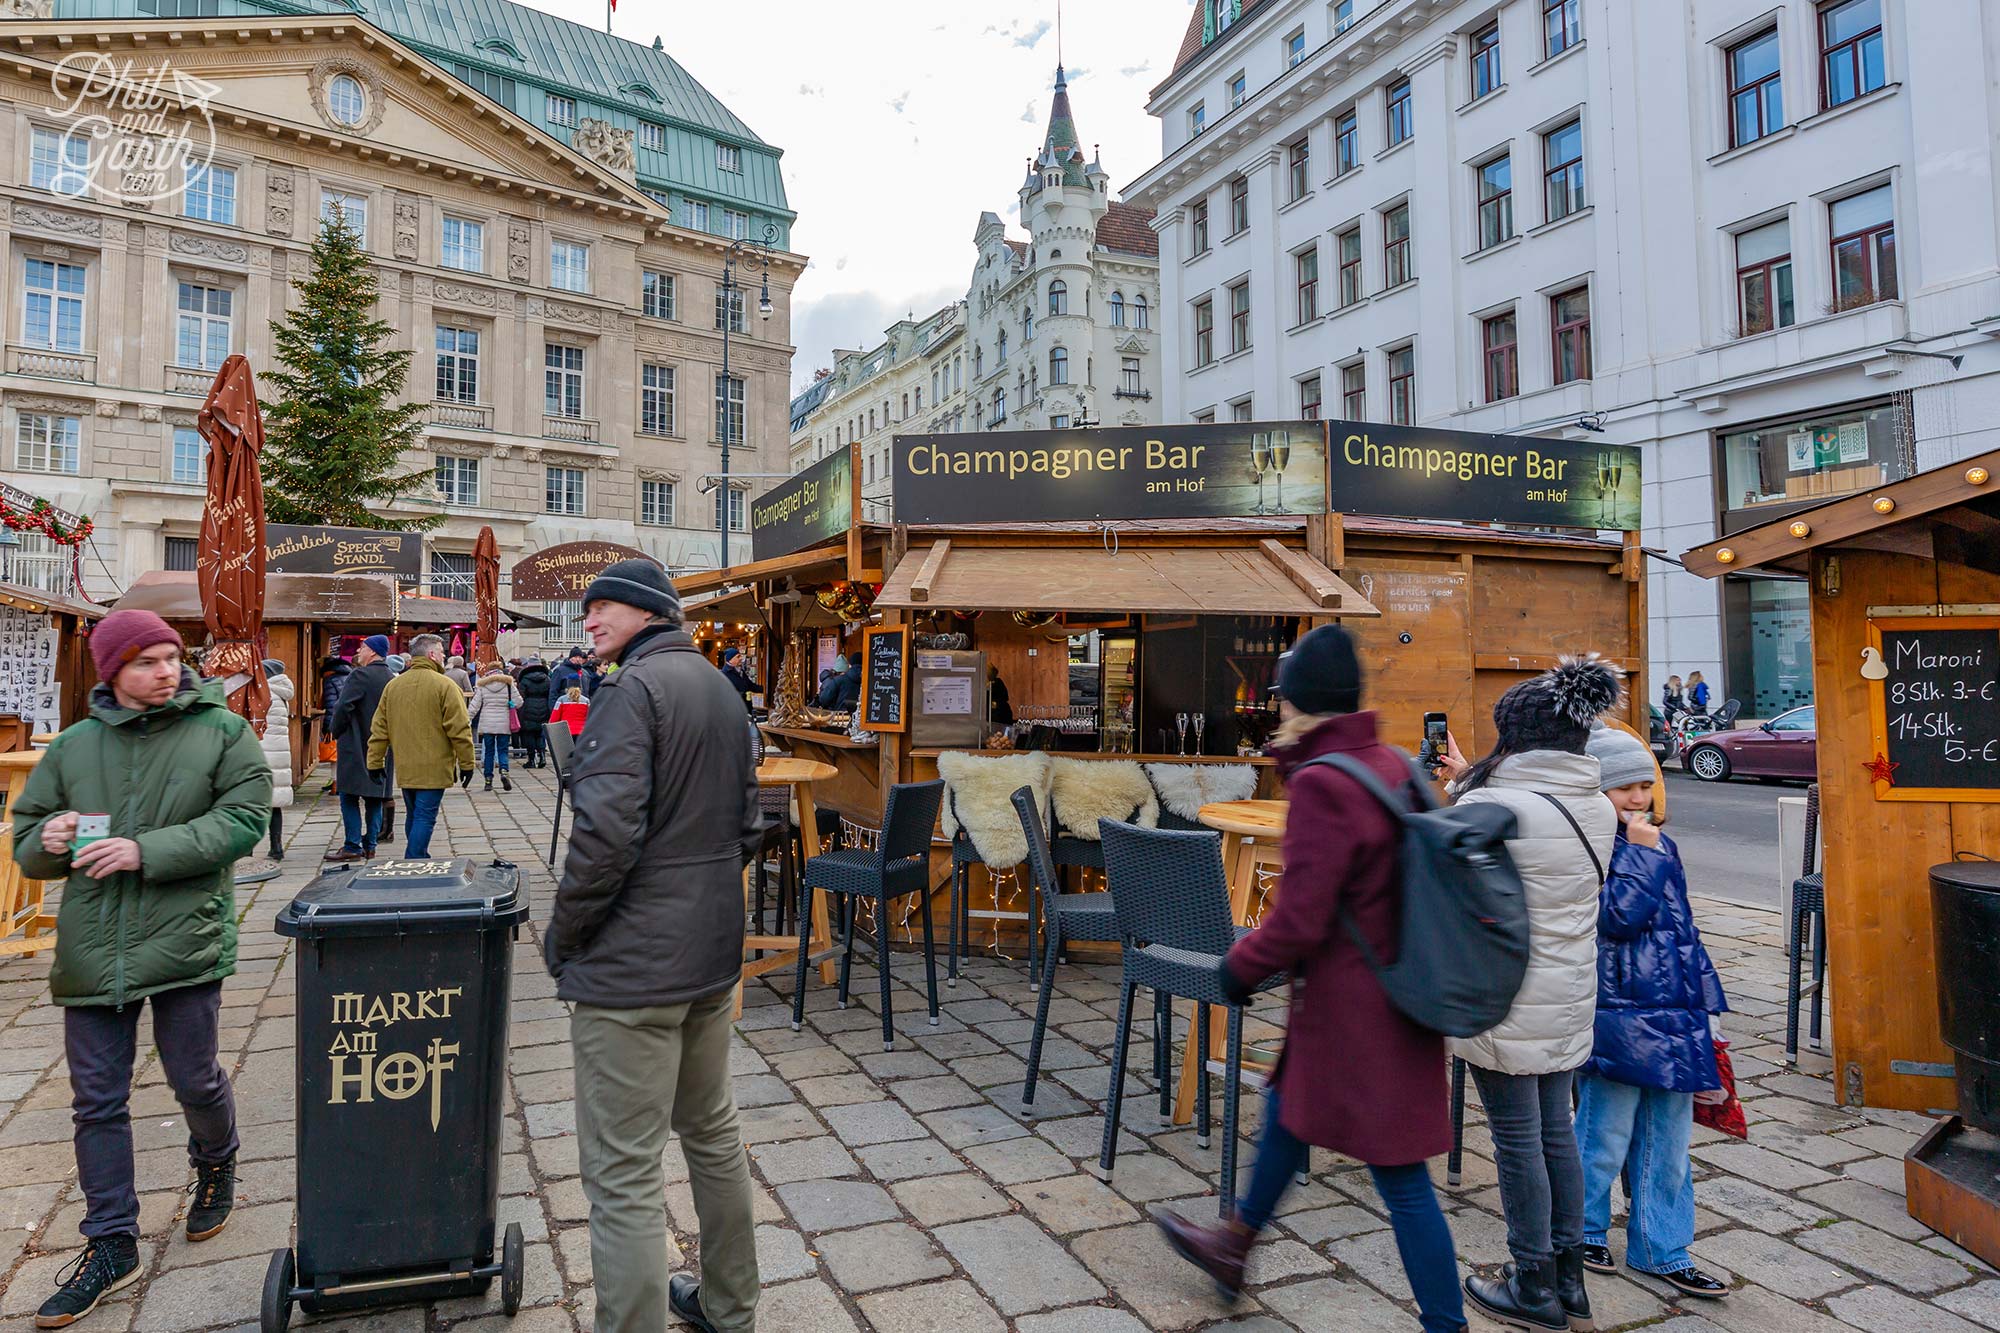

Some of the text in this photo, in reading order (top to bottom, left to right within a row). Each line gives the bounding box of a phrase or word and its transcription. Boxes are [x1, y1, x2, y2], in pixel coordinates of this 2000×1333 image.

[907, 440, 1206, 479] Champagner Bar
[1343, 434, 1568, 481] Champagner Bar
[1146, 477, 1205, 493] am Hof
[1526, 488, 1568, 503] am Hof
[753, 480, 820, 529] Champagner Bar
[804, 507, 820, 526] am Hof
[535, 550, 602, 573] Weihnachts
[1896, 639, 1982, 671] Maroni
[366, 868, 449, 877] MARKT
[330, 986, 463, 1028] MARKT
